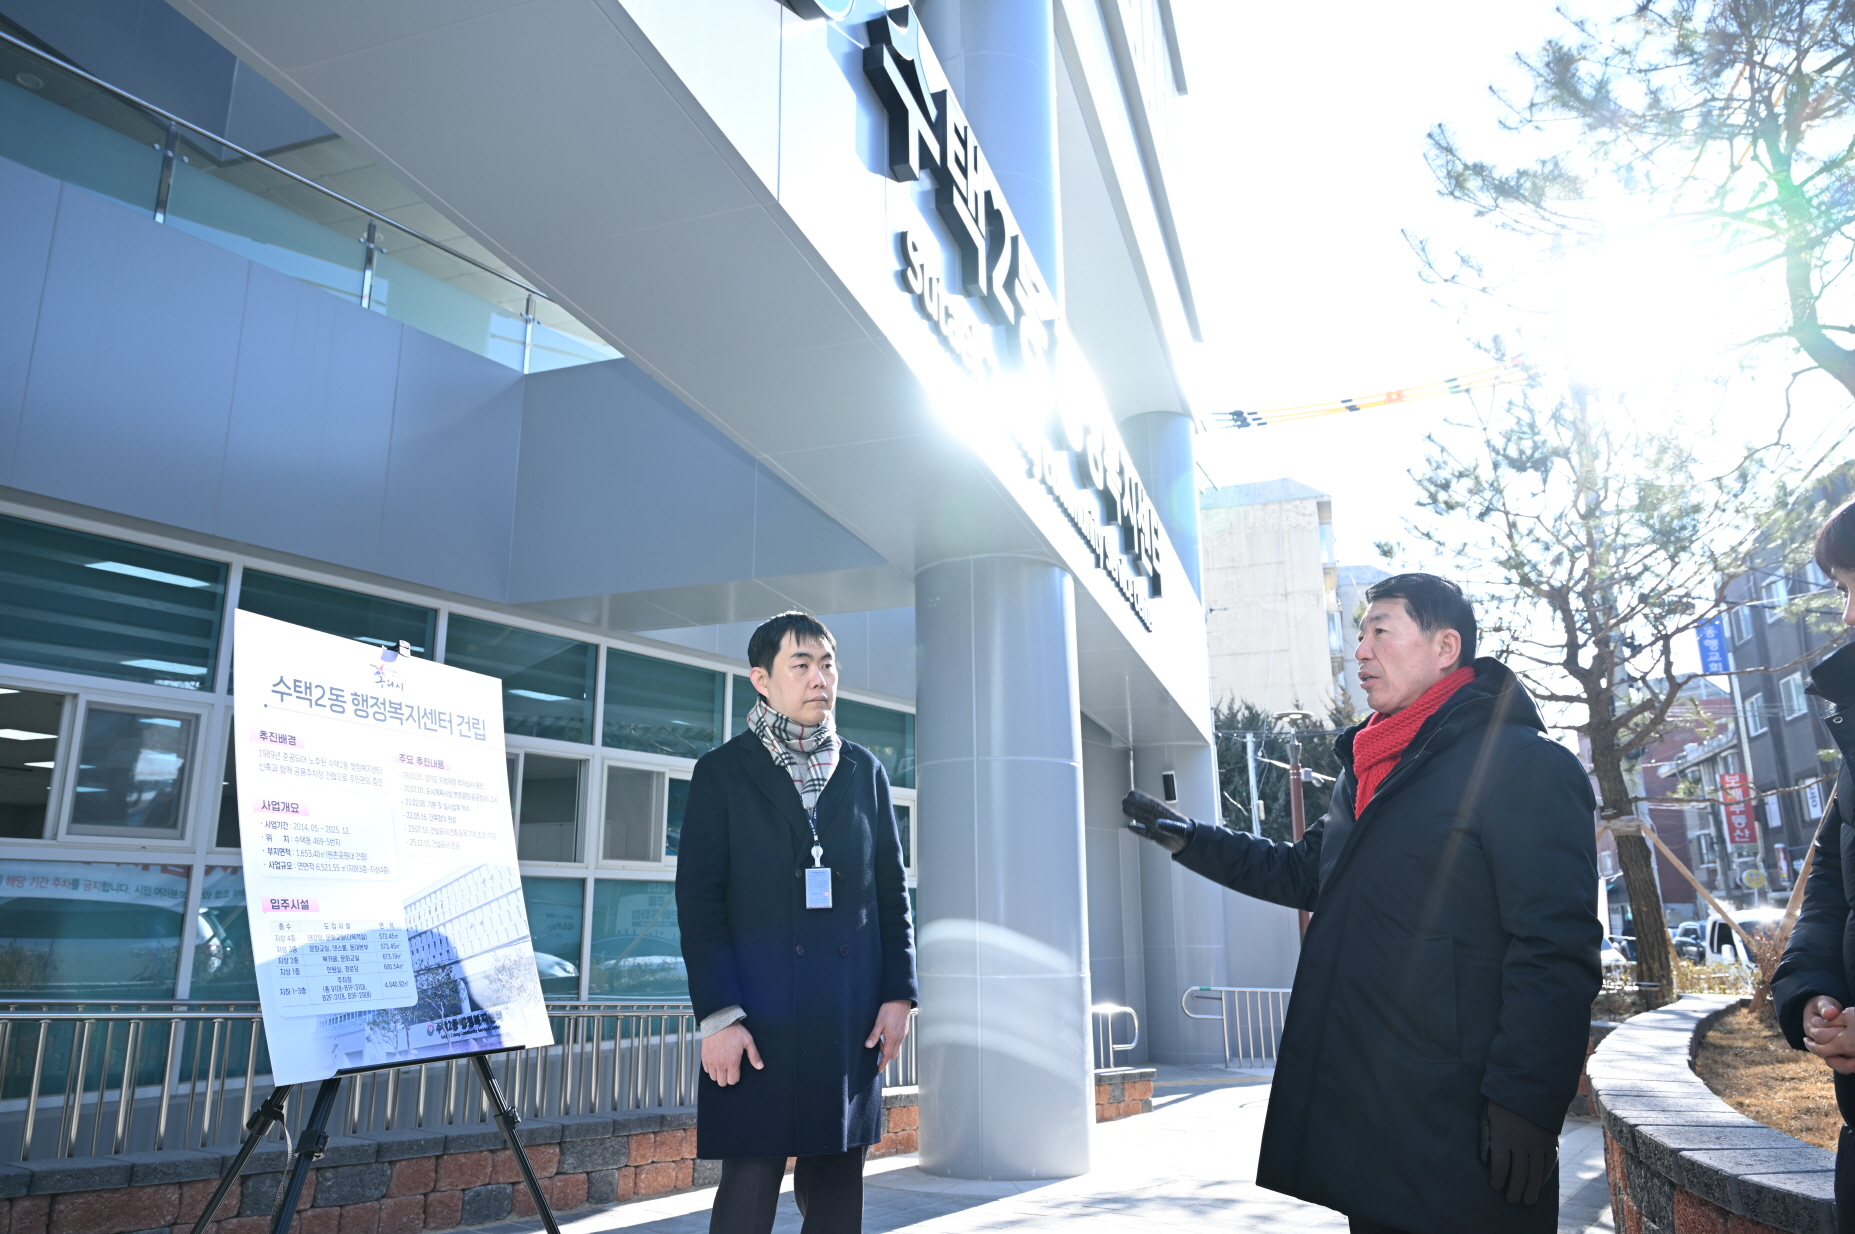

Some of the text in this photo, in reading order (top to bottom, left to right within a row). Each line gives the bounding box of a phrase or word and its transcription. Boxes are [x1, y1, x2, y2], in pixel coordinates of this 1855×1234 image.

[270, 675, 487, 742] 수택2동 행정복지센터 건립
[259, 729, 297, 746] 추진배경
[398, 753, 445, 770] 주요 추진내용
[261, 799, 300, 814] 사업개요
[264, 820, 351, 835] 사업기간 2014. 05. 2025. 12.
[266, 834, 273, 843] 위
[283, 834, 290, 844] 치
[294, 835, 312, 846] 수택동
[268, 860, 293, 871] 사업규모
[6, 875, 26, 888] 해당
[29, 876, 49, 889] 기간
[52, 877, 80, 891] 주차를
[83, 879, 131, 894] 금지합니다.
[134, 885, 152, 897] 시민
[270, 898, 310, 911] 입주시설
